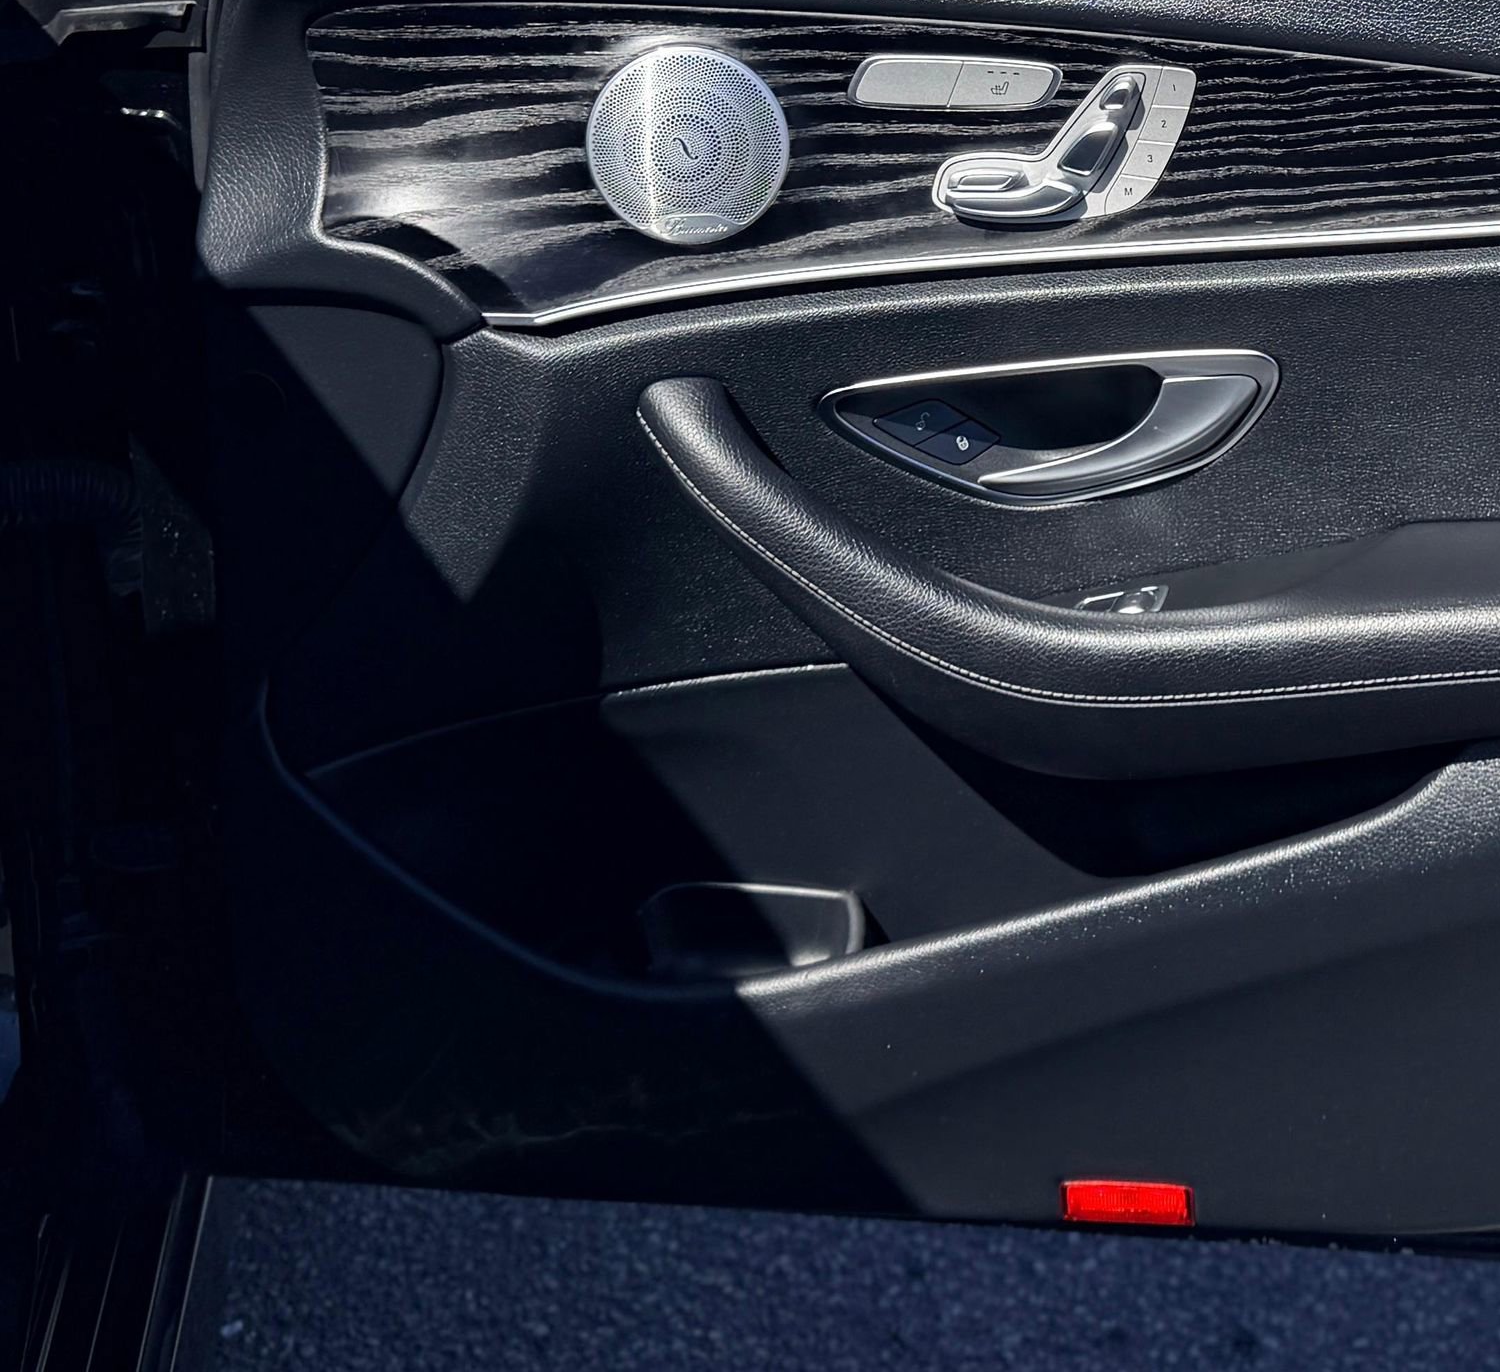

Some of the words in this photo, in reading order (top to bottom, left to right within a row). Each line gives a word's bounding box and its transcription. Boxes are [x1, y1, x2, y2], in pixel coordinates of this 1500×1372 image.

[1161, 119, 1168, 128] 2
[1147, 154, 1153, 163] 3
[1124, 187, 1133, 196] M
